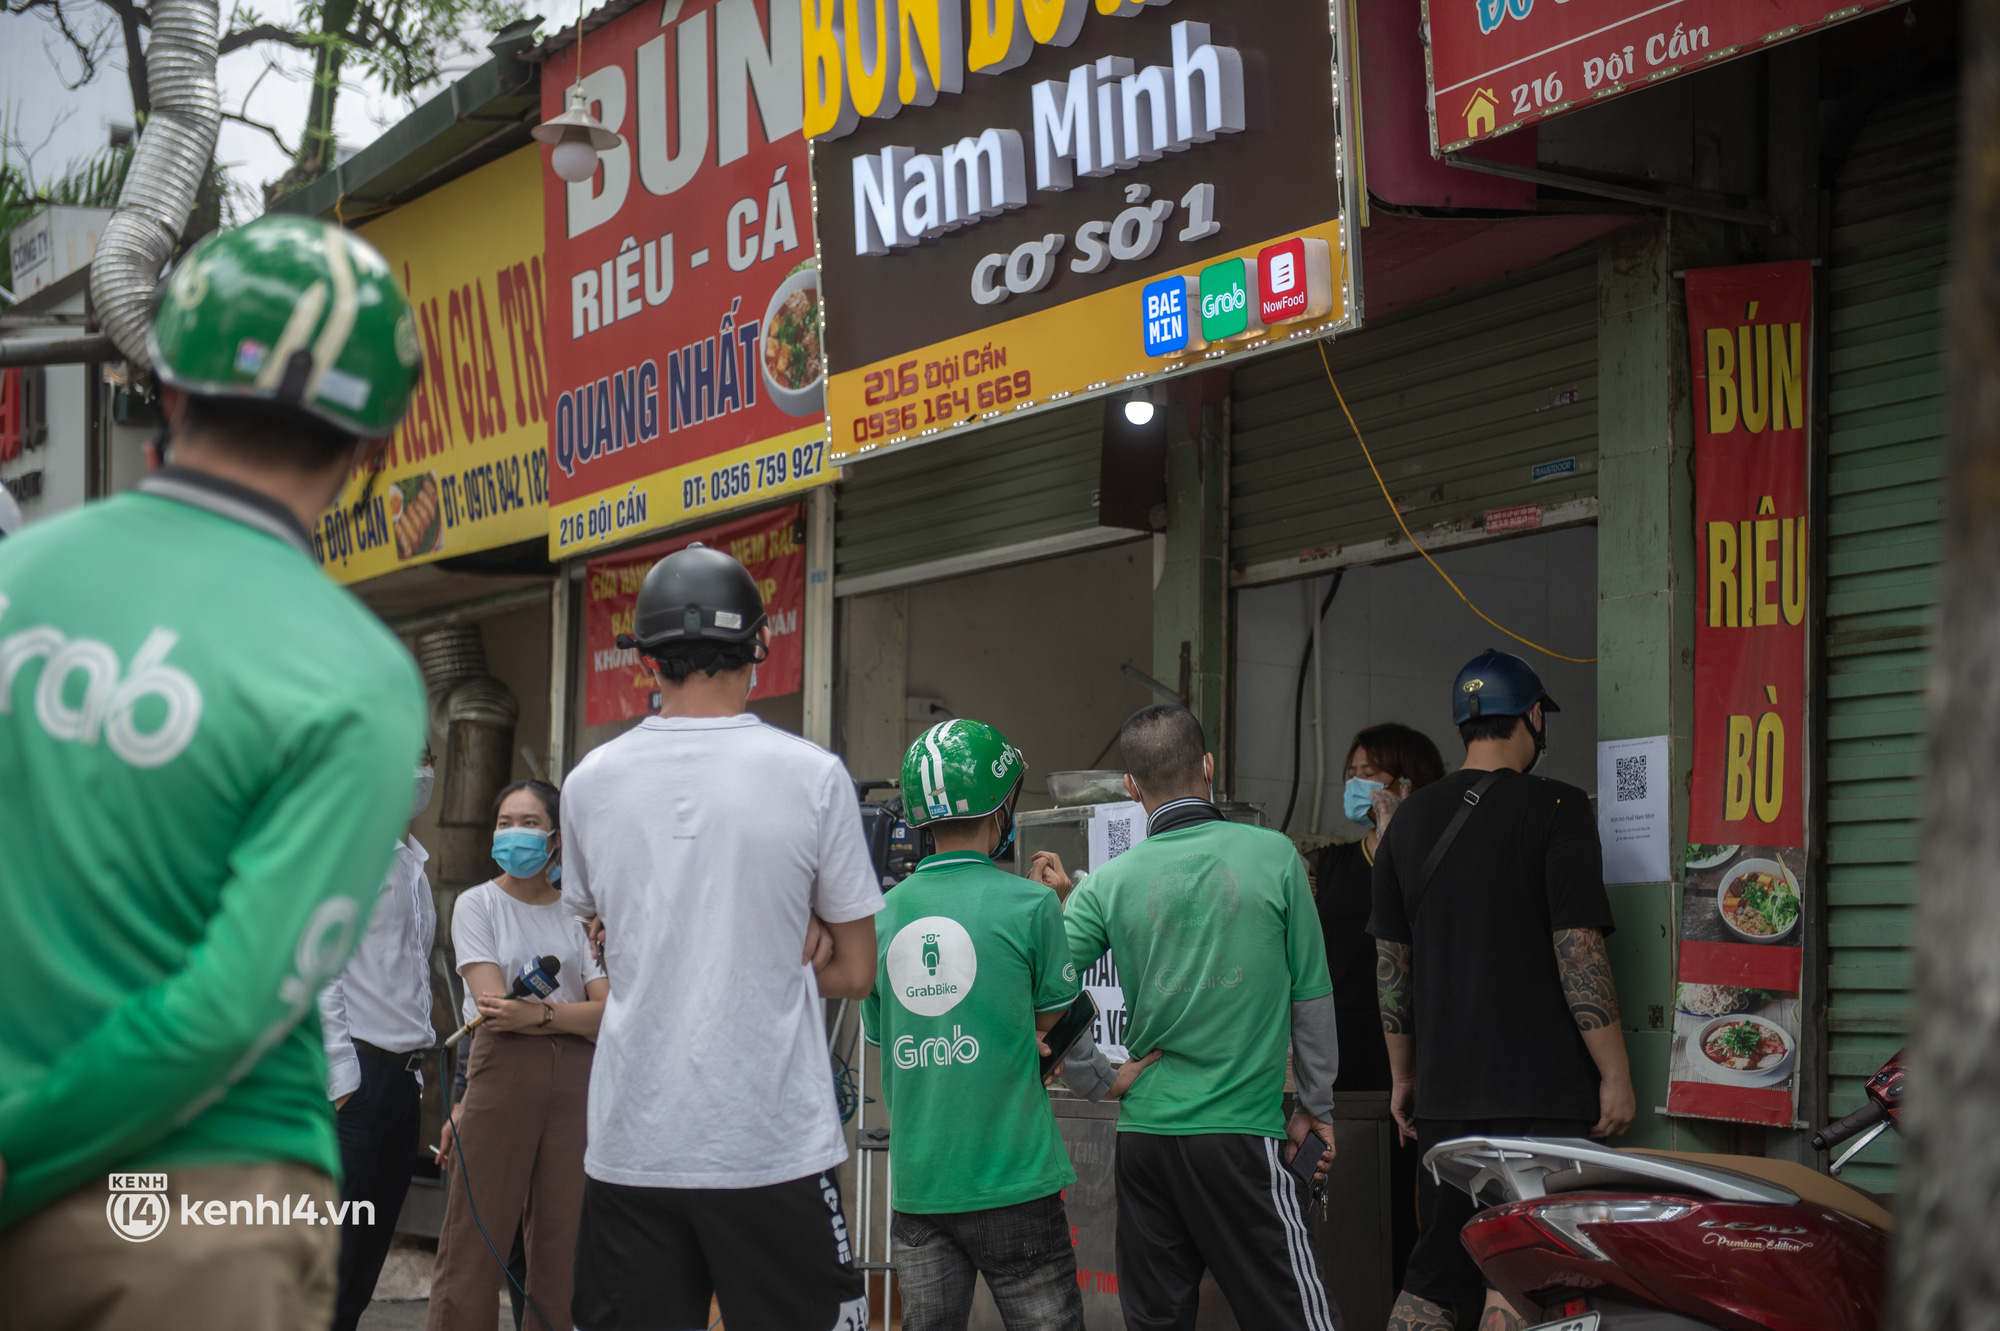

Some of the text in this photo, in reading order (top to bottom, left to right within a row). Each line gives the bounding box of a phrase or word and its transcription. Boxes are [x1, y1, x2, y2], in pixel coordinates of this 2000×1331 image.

[1511, 22, 1710, 116] 216 Đội Cấn
[852, 128, 1028, 256] Nam
[1031, 20, 1246, 191] Minh
[1179, 182, 1221, 242] 1
[571, 164, 799, 340] RIÊU - CÁ
[1148, 289, 1181, 319] BAE
[1149, 314, 1182, 345] MIN
[1202, 282, 1246, 319] Grab
[1263, 291, 1305, 315] NowFood
[448, 275, 507, 446] GIA
[497, 250, 549, 428] TR
[864, 360, 919, 406] 216
[924, 355, 959, 389] Đội
[1703, 301, 1804, 435] BÚN
[556, 296, 760, 477] QUANG NHẤT
[853, 369, 1032, 443] 0936 164 669
[559, 440, 826, 548] 216 ĐỘI CẤN ĐT: 0356 759 927
[1706, 495, 1806, 628] RIÊU
[0, 624, 203, 769] rab
[1722, 685, 1785, 824] BÒ
[906, 983, 957, 997] GrabBike
[893, 1025, 980, 1069] Grab
[1698, 1219, 1809, 1235] LEAD
[1702, 1232, 1814, 1252] Premium Edition
